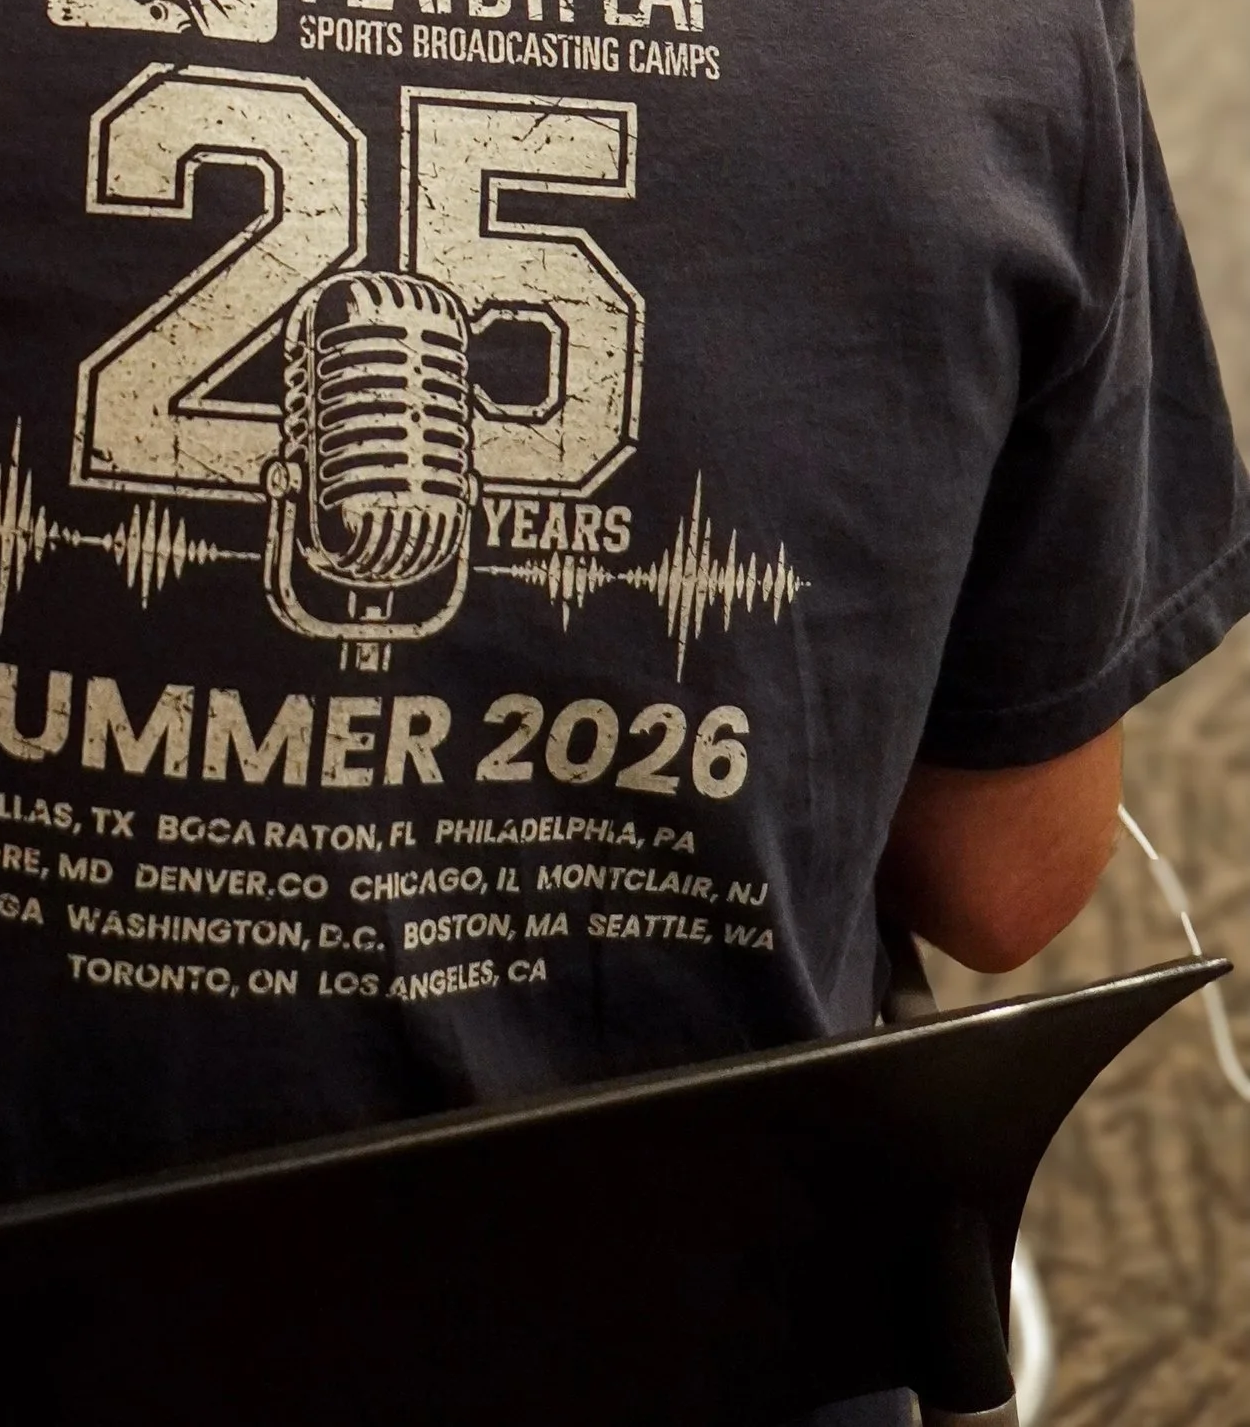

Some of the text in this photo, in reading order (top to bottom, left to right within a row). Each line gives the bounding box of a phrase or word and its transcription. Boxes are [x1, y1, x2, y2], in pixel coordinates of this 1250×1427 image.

[300, 15, 720, 79] SPORTS BROADCASTING CAMPS
[70, 62, 646, 501] 25
[482, 498, 632, 553] YEARS
[476, 694, 750, 799] 2026
[92, 807, 134, 837] TX
[158, 815, 255, 845] BOCA
[265, 822, 382, 852] RATON,
[390, 821, 416, 847] FL
[435, 816, 644, 848] PHILADELPHIA,
[653, 828, 694, 854] PA
[59, 854, 113, 883] MD
[350, 867, 487, 901] CHICAGO,
[497, 867, 519, 892] IL
[537, 864, 718, 902] MONTCLAIR,
[726, 882, 768, 905] NJ
[68, 905, 310, 951] WASHINGTON,
[319, 924, 384, 951] D.C.
[404, 914, 515, 950] BOSTON,
[525, 913, 568, 937] MA
[588, 914, 711, 943] SEATTLE,
[725, 924, 773, 950] WA
[69, 955, 546, 1001] TORONTO, ON LOS ANGELES, CA
